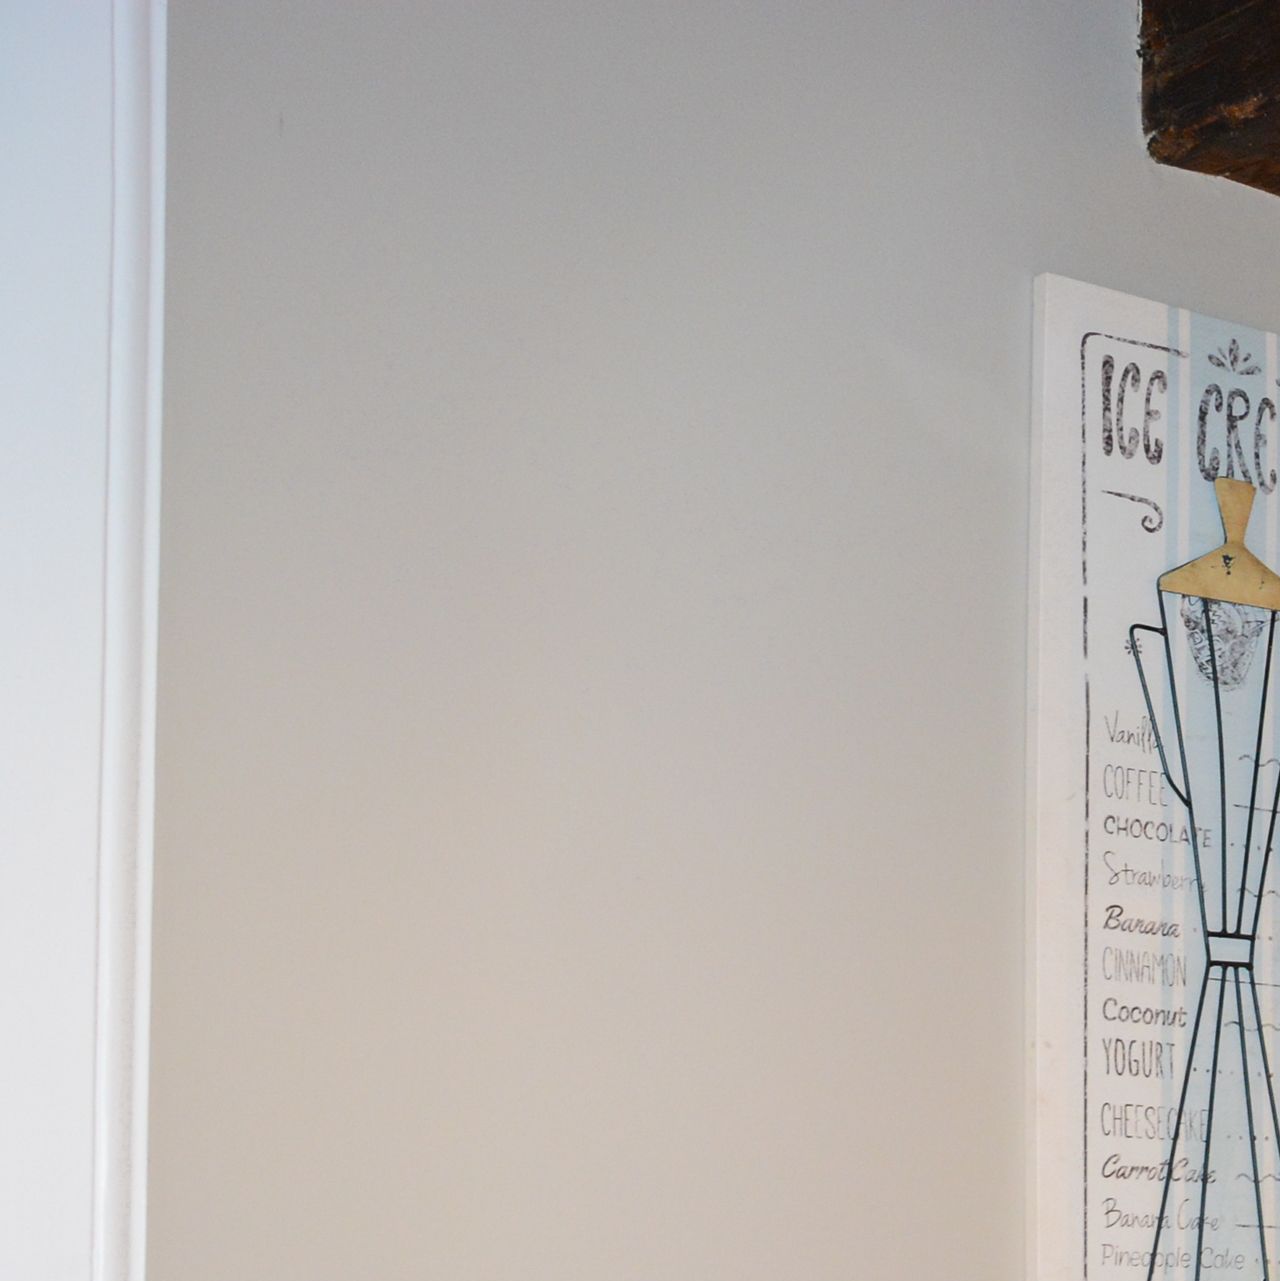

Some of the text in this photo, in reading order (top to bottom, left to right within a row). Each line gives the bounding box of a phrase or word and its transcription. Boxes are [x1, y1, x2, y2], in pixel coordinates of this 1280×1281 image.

[1101, 354, 1168, 465] ICE
[1104, 710, 1164, 754] Vanill
[1103, 764, 1168, 807] COFFEE
[1103, 851, 1208, 893] Strawberr
[1102, 946, 1188, 987] CINNAMON
[1102, 998, 1188, 1028] Coconut
[1102, 1038, 1176, 1080] YOGURT
[1100, 1102, 1209, 1142] CHEESECAKE
[1102, 1154, 1170, 1181] Carrot
[1101, 1243, 1192, 1274] Pineapple
[1199, 1247, 1246, 1270] Cake
